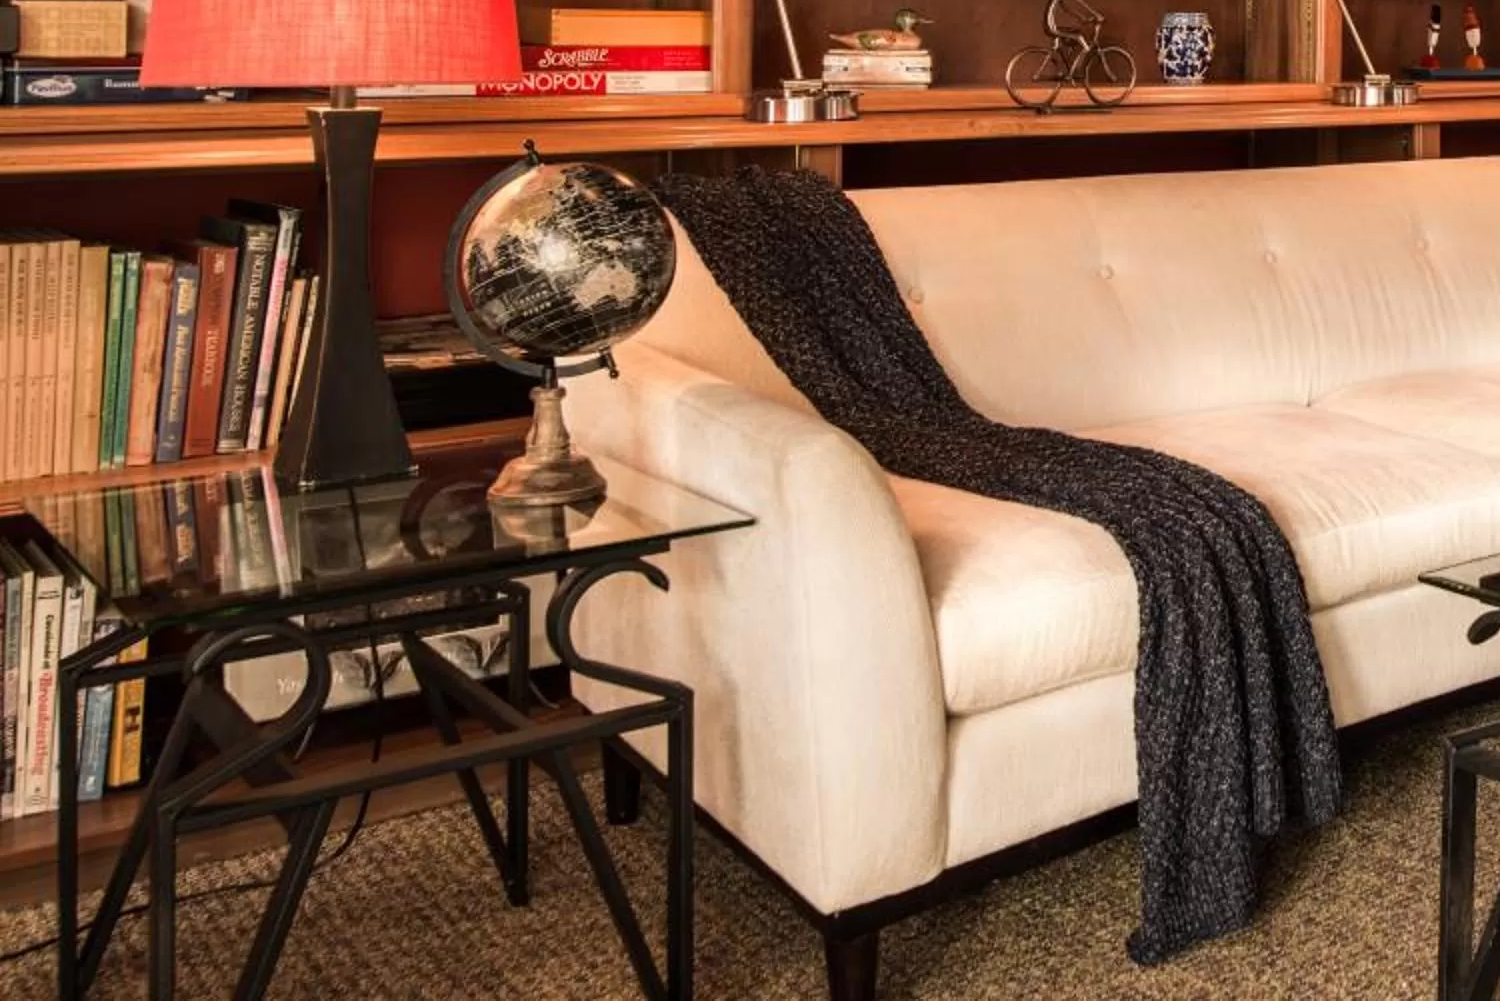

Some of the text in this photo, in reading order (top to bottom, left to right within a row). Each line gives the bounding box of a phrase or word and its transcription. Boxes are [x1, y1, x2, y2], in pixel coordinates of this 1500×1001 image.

[228, 253, 266, 433] NOTABLE AMERICAN HOUSES
